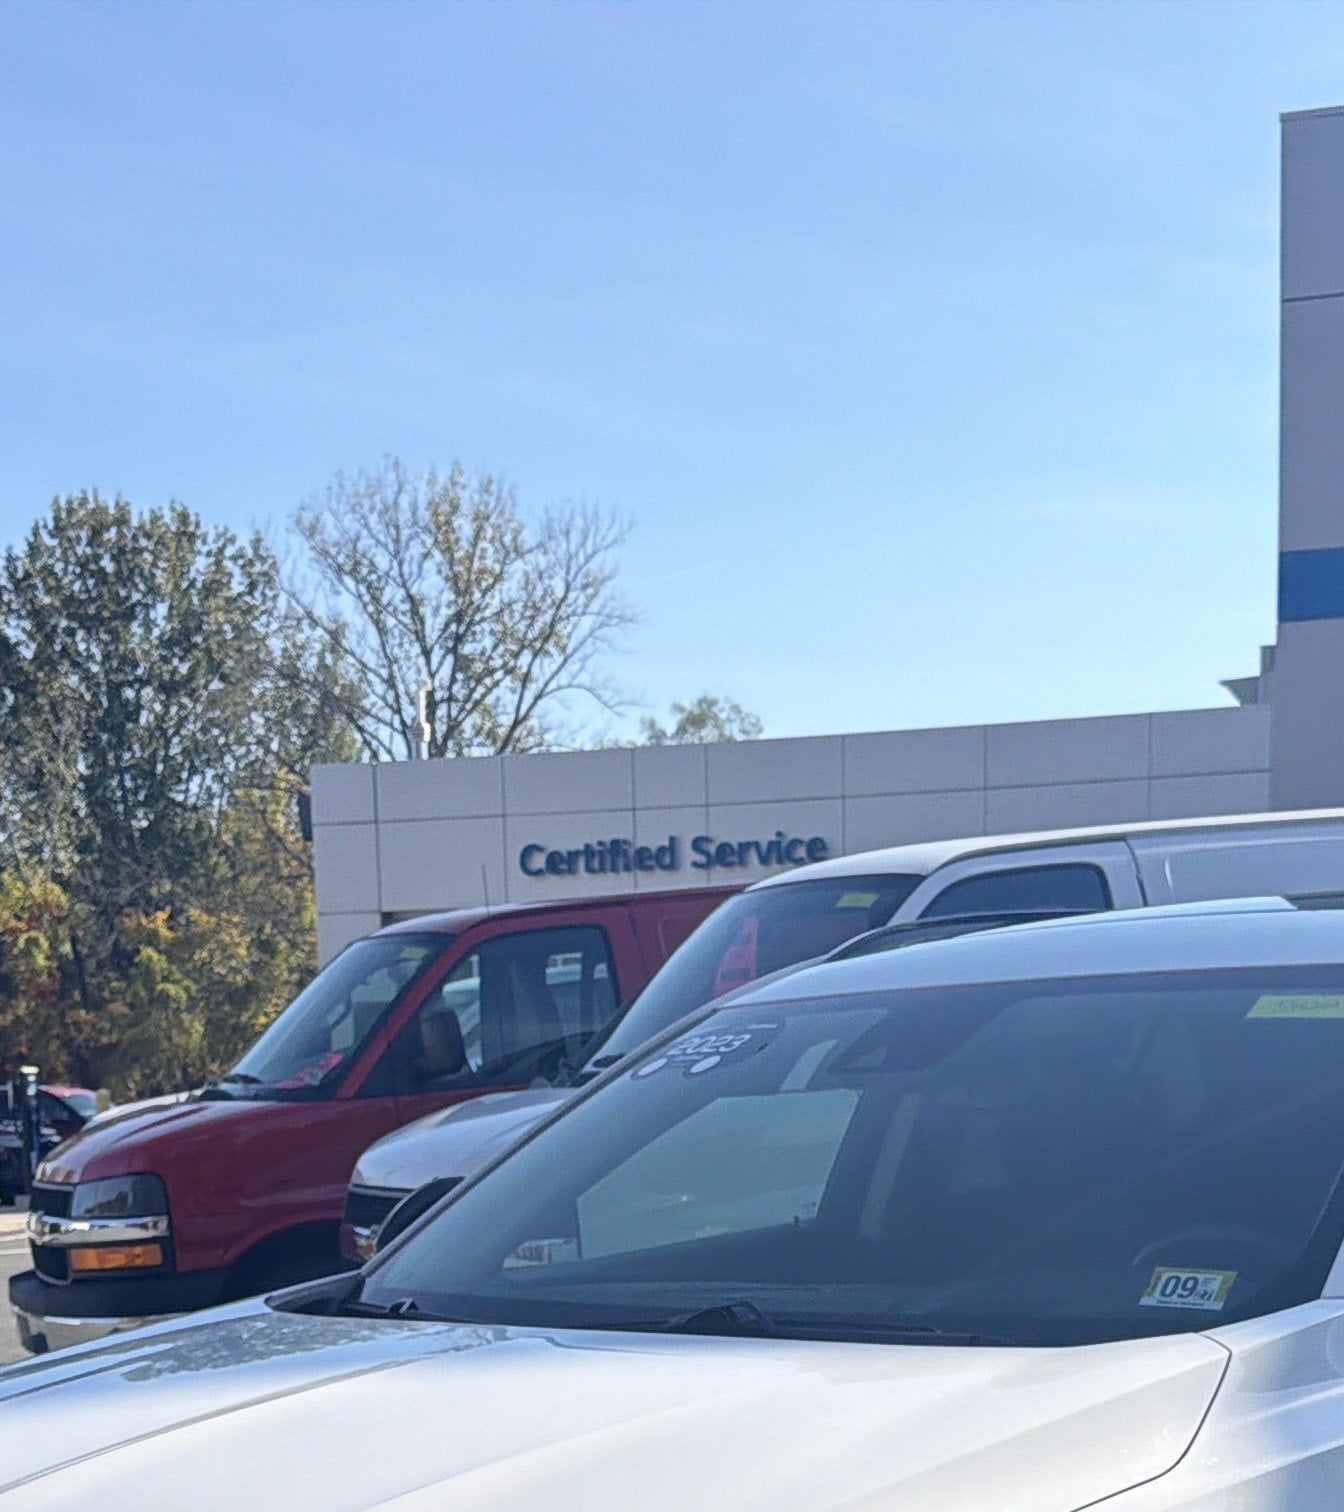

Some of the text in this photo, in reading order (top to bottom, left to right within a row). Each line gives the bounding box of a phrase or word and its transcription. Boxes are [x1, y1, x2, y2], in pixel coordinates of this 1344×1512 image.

[519, 831, 829, 877] Certified Service
[667, 1034, 751, 1055] 2023
[1160, 1275, 1199, 1298] 09
